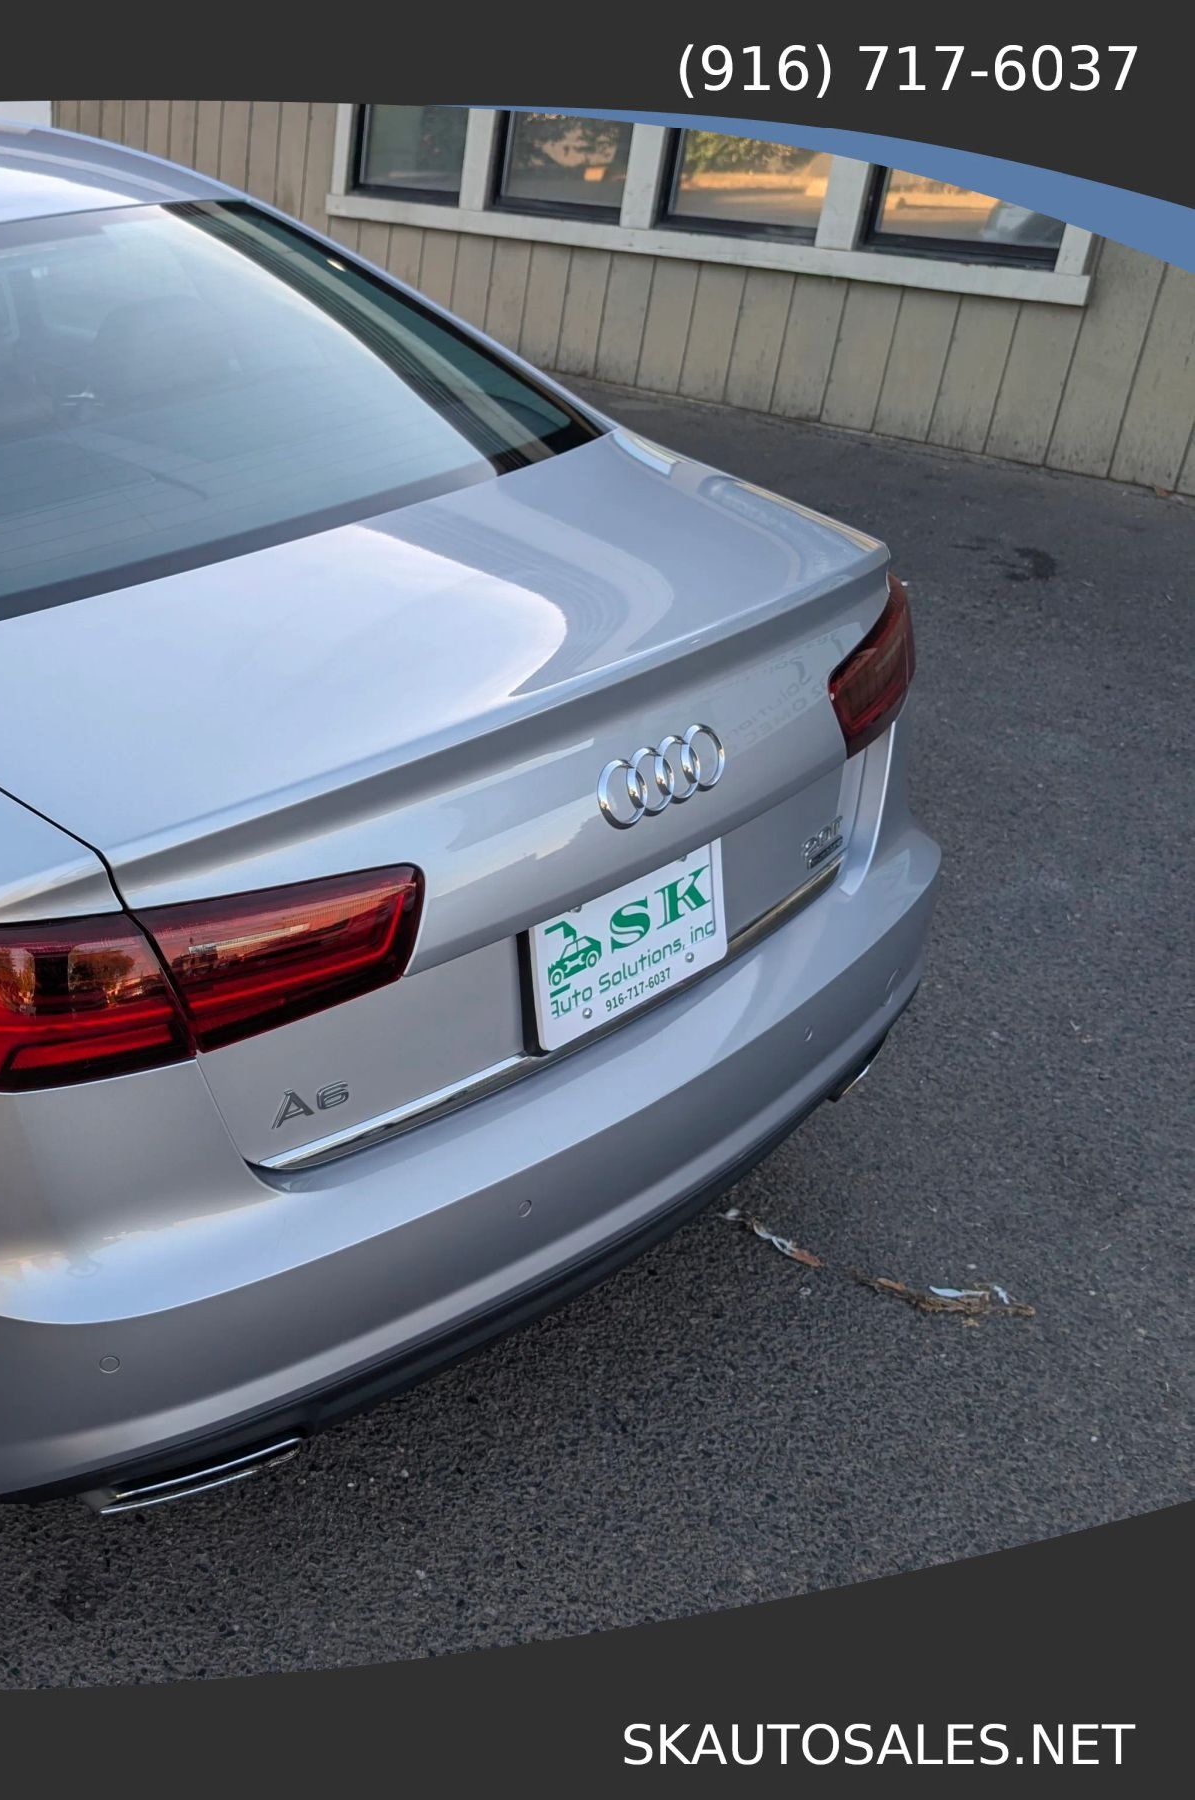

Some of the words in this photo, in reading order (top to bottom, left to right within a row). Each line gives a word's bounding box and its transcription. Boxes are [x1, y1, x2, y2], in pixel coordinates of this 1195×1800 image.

[609, 864, 712, 954] SK
[551, 986, 593, 1020] Auto
[599, 937, 686, 996] Solutions,
[690, 920, 715, 944] inc
[605, 967, 672, 1013] 916-717-6037
[270, 1080, 350, 1130] A6
